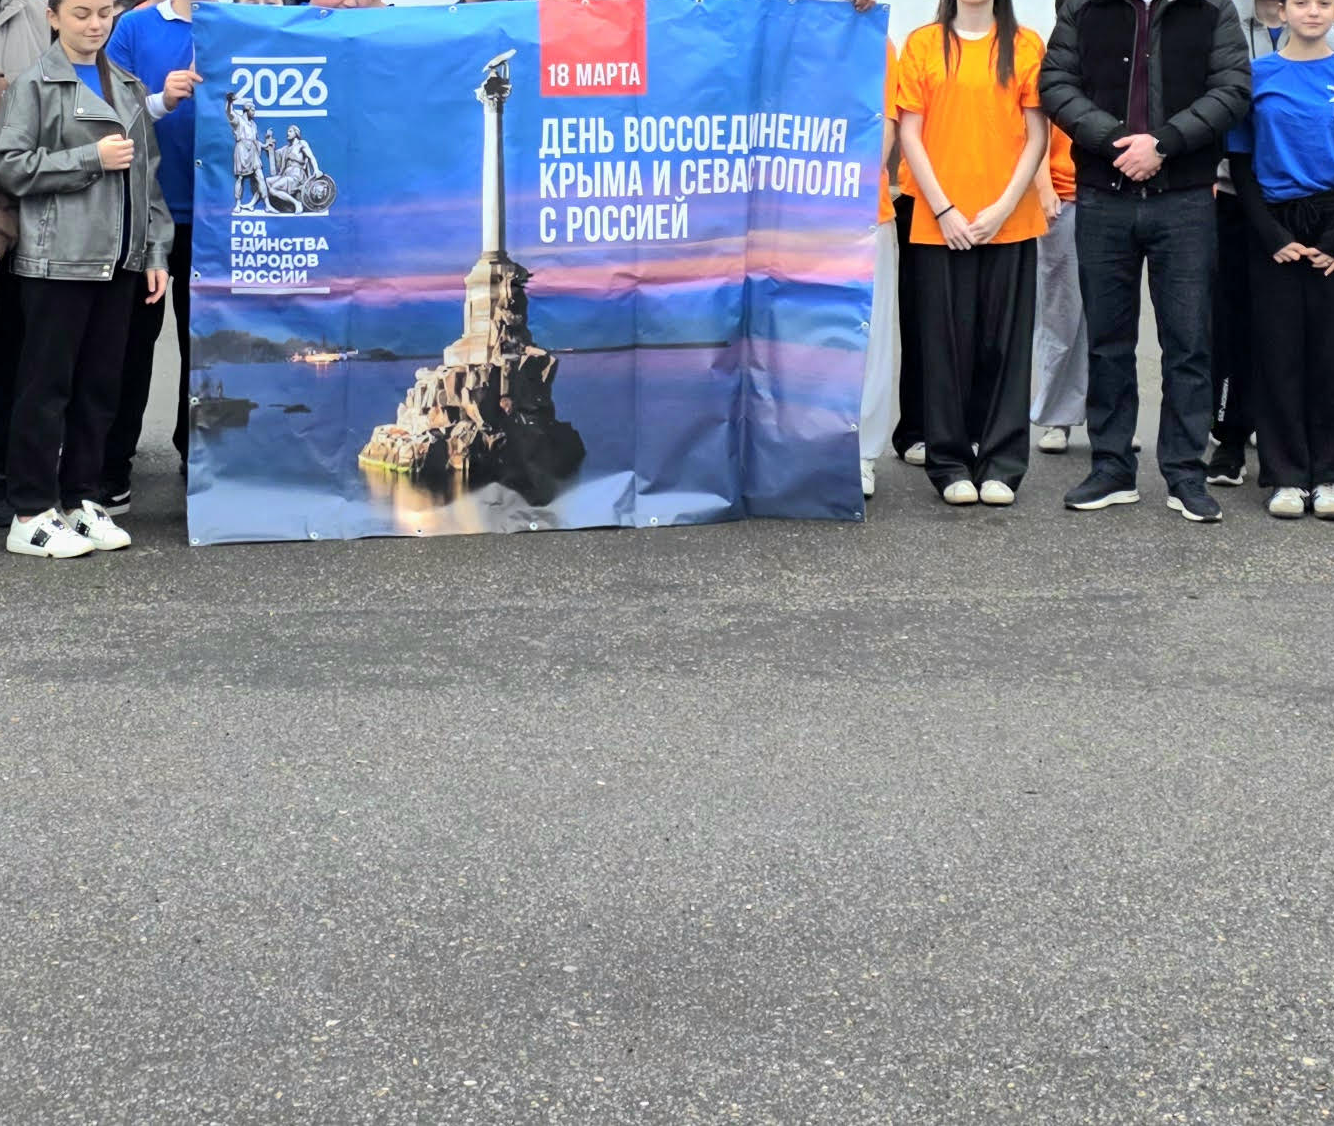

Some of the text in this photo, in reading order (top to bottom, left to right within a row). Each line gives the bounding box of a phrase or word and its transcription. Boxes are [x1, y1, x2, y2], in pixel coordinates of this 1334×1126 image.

[231, 67, 328, 106] 2026
[547, 61, 642, 87] 18 МАРТА
[538, 112, 849, 159] ДЕНЬ ВОССОЕДИНЕНИЯ
[539, 154, 862, 200] КРЫМА И СЕВАСТОПОЛЯ
[230, 220, 267, 237] ГОД
[539, 194, 688, 244] С РОССИЕЙ
[230, 236, 330, 253] ЕДИНСТВА
[230, 253, 320, 270] НАРОДОВ
[230, 269, 308, 284] РОССИИ
